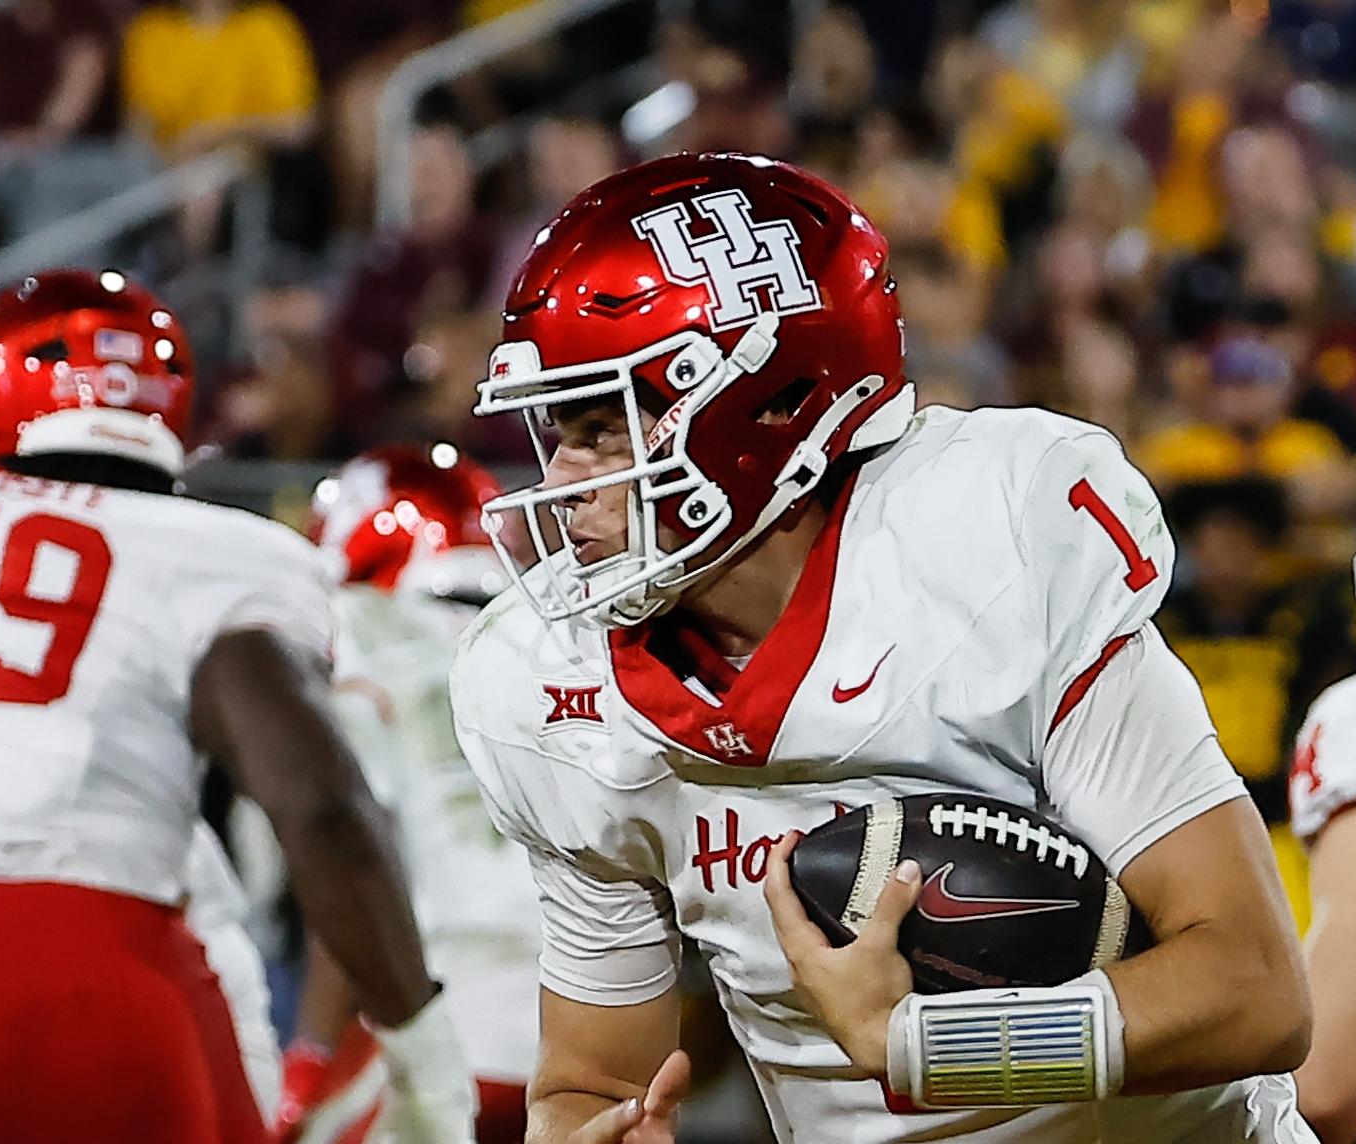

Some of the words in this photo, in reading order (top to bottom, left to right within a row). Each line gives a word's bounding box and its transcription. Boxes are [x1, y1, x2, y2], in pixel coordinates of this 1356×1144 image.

[631, 189, 822, 333] UH
[1067, 477, 1159, 593] 1
[542, 684, 604, 724] XII
[702, 722, 753, 758] UH
